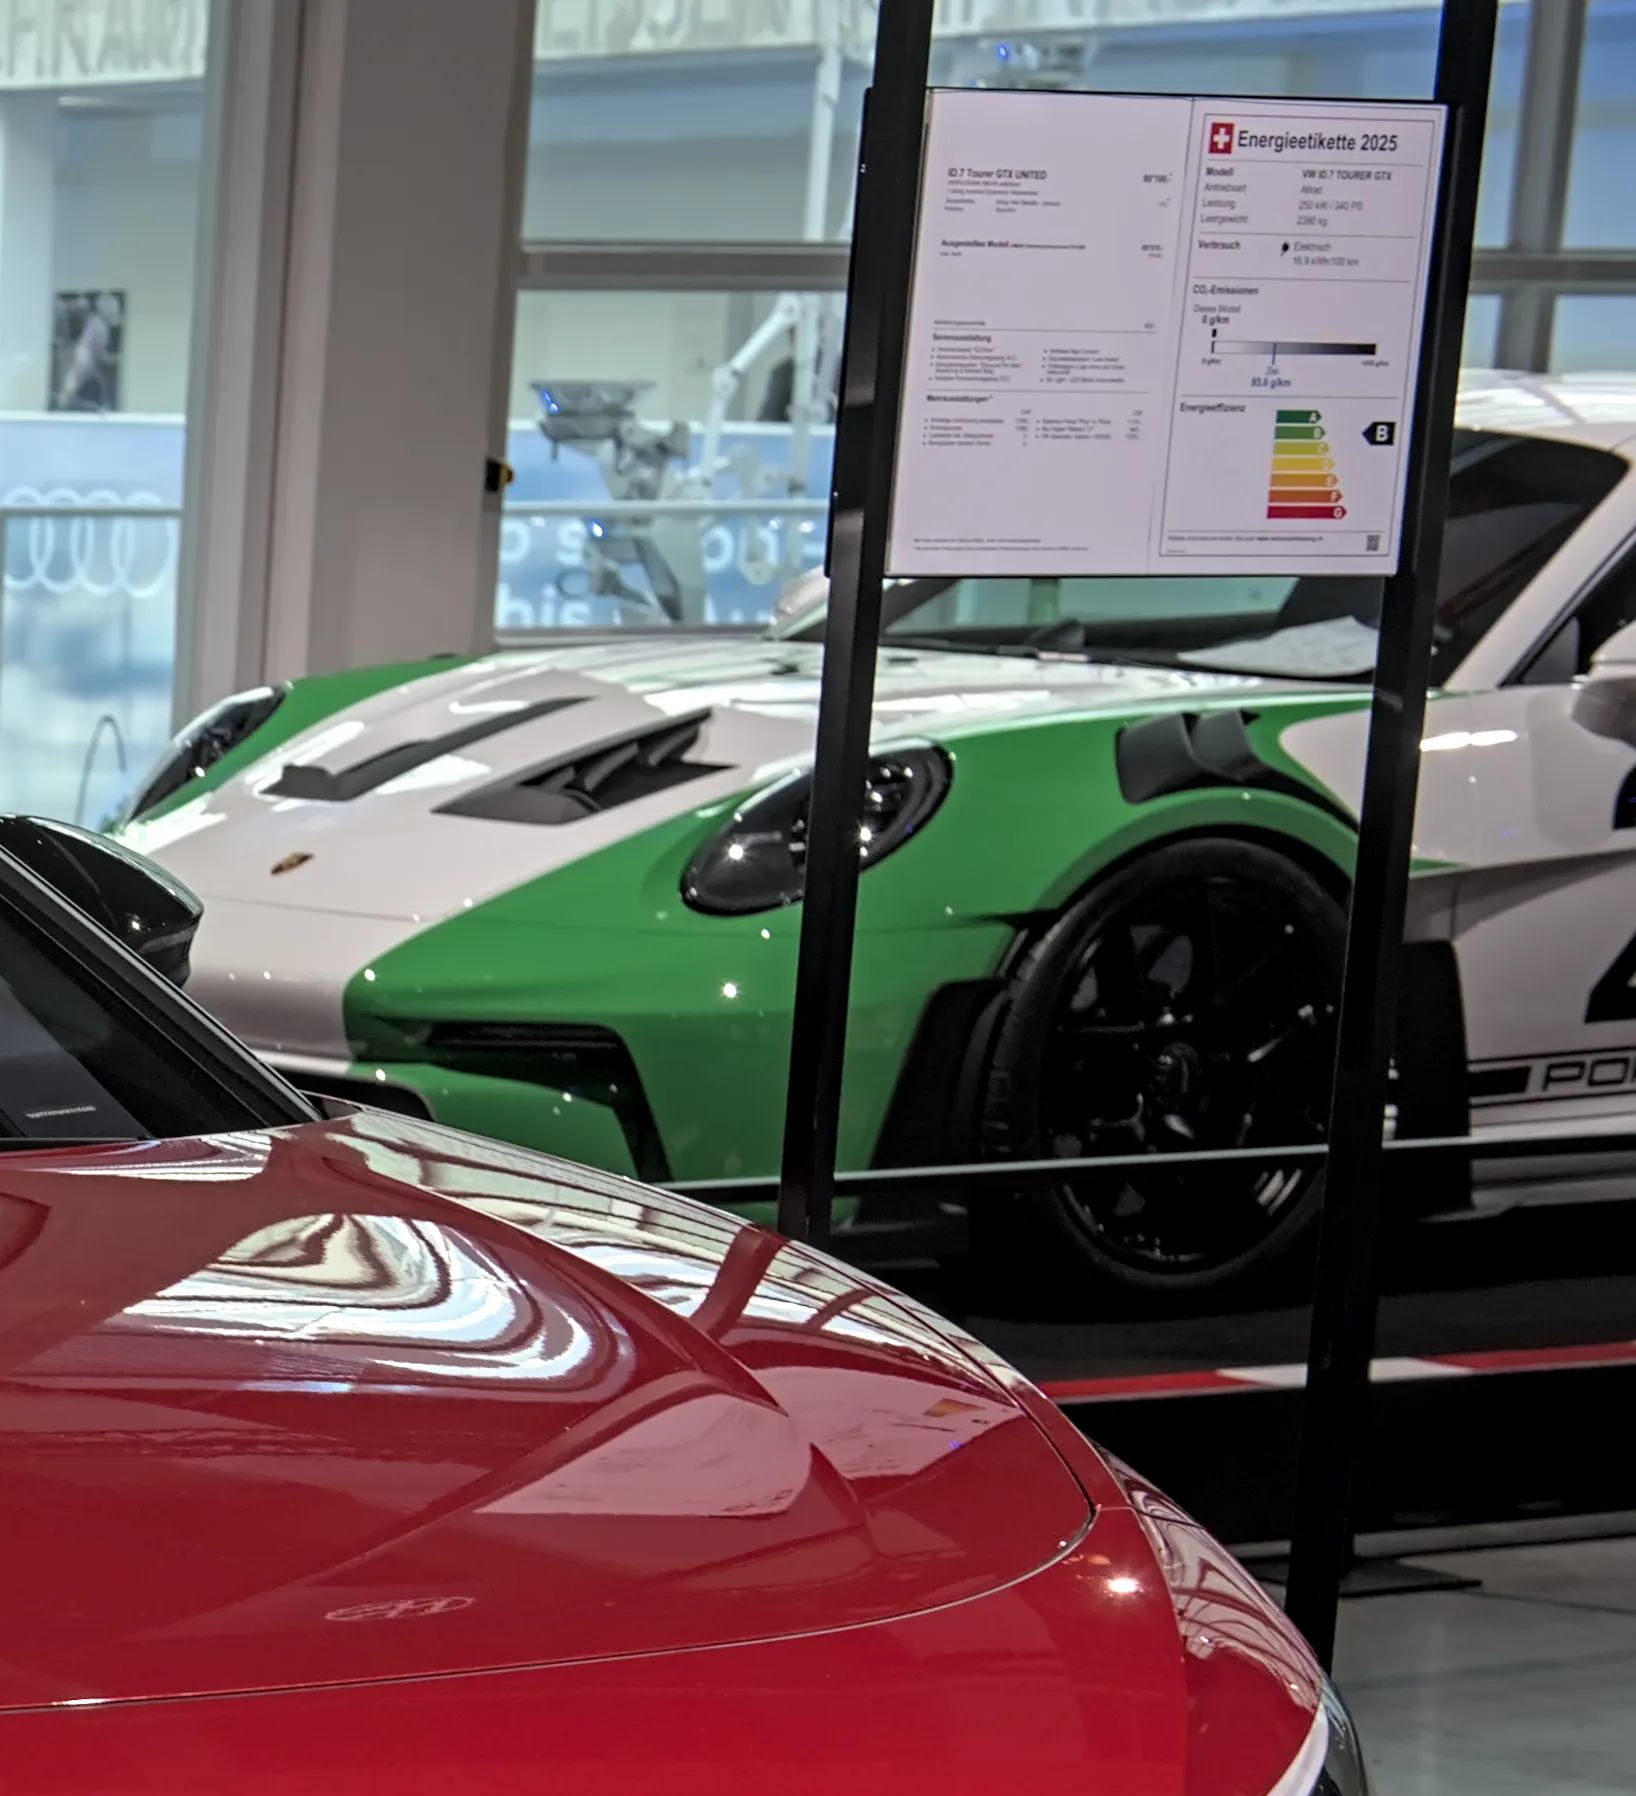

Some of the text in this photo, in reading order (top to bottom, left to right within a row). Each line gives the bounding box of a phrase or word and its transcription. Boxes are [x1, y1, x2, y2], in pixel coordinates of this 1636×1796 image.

[1237, 130, 1398, 153] Energieetikette 2025
[1014, 170, 1047, 180] UNITED
[1205, 167, 1234, 177] Modell
[1302, 169, 1317, 179] VW
[1336, 170, 1372, 181] TOURER
[1373, 171, 1392, 181] GTX
[1198, 240, 1241, 250] Verbrauch
[1308, 412, 1317, 423] A
[1312, 427, 1322, 438] B
[1375, 425, 1388, 442] B
[1333, 508, 1342, 518] G
[1541, 1057, 1636, 1092] PO
